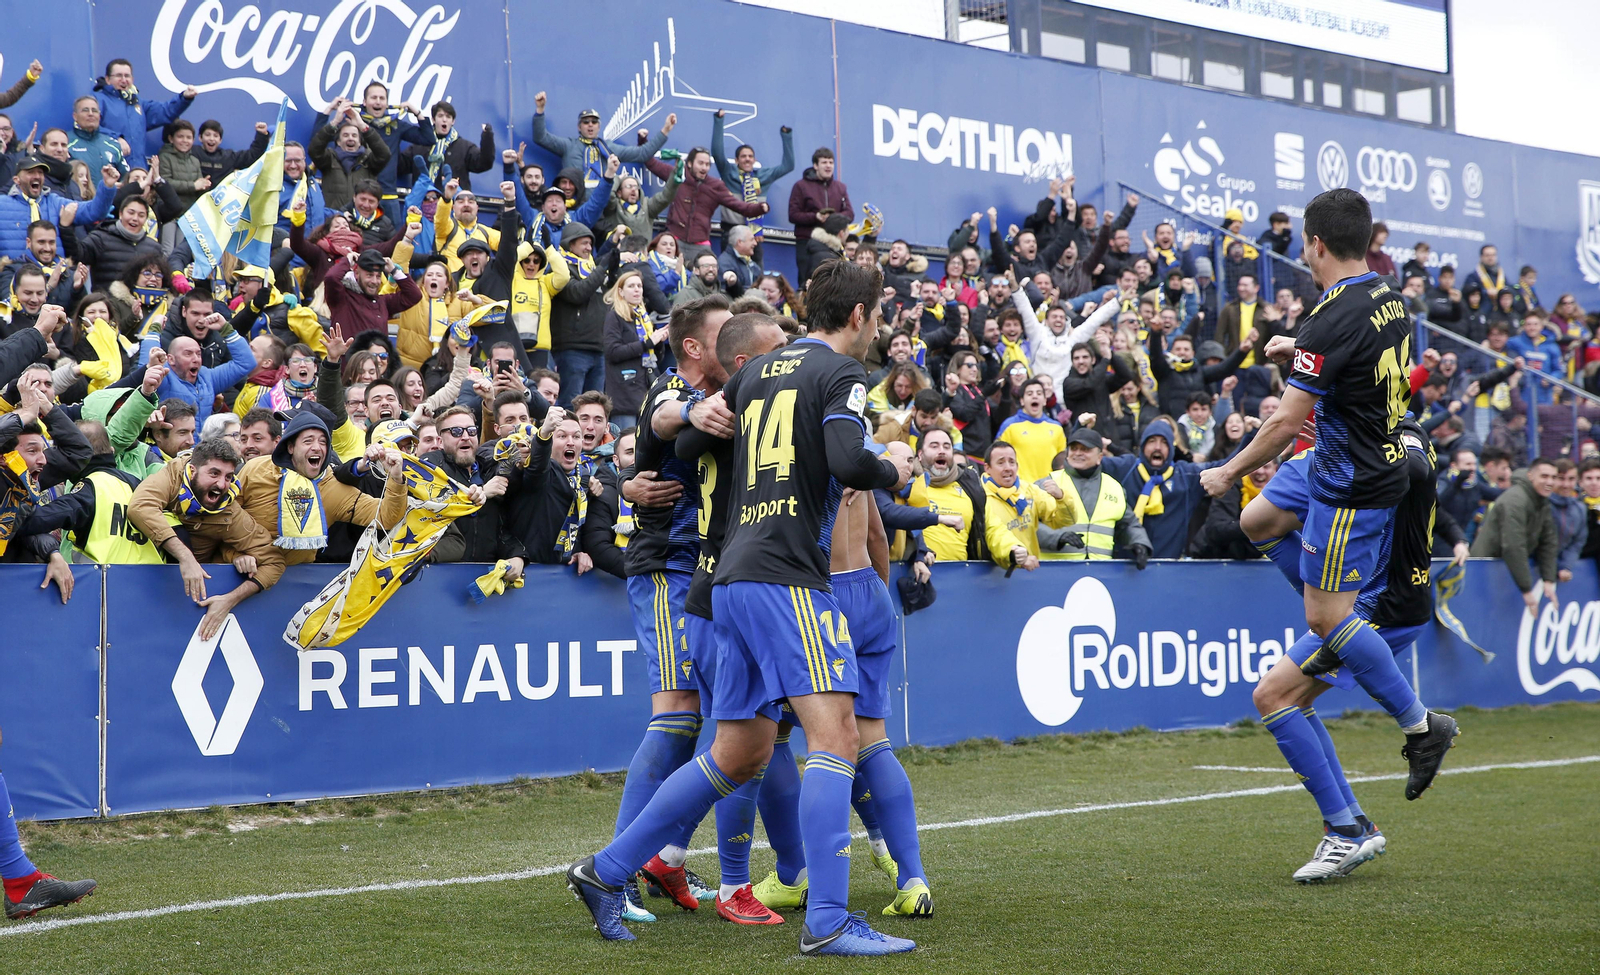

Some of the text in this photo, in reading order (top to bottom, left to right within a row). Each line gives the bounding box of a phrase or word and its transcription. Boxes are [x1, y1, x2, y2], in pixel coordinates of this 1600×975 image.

[872, 104, 1073, 182] DECATHLON
[1216, 173, 1256, 194] Grupo
[1369, 300, 1405, 333] MATOS
[740, 388, 798, 491] 14
[739, 495, 798, 526] Bayport
[819, 610, 853, 649] 14
[298, 640, 637, 711] RENAULT
[1073, 627, 1295, 698] RolDigital
